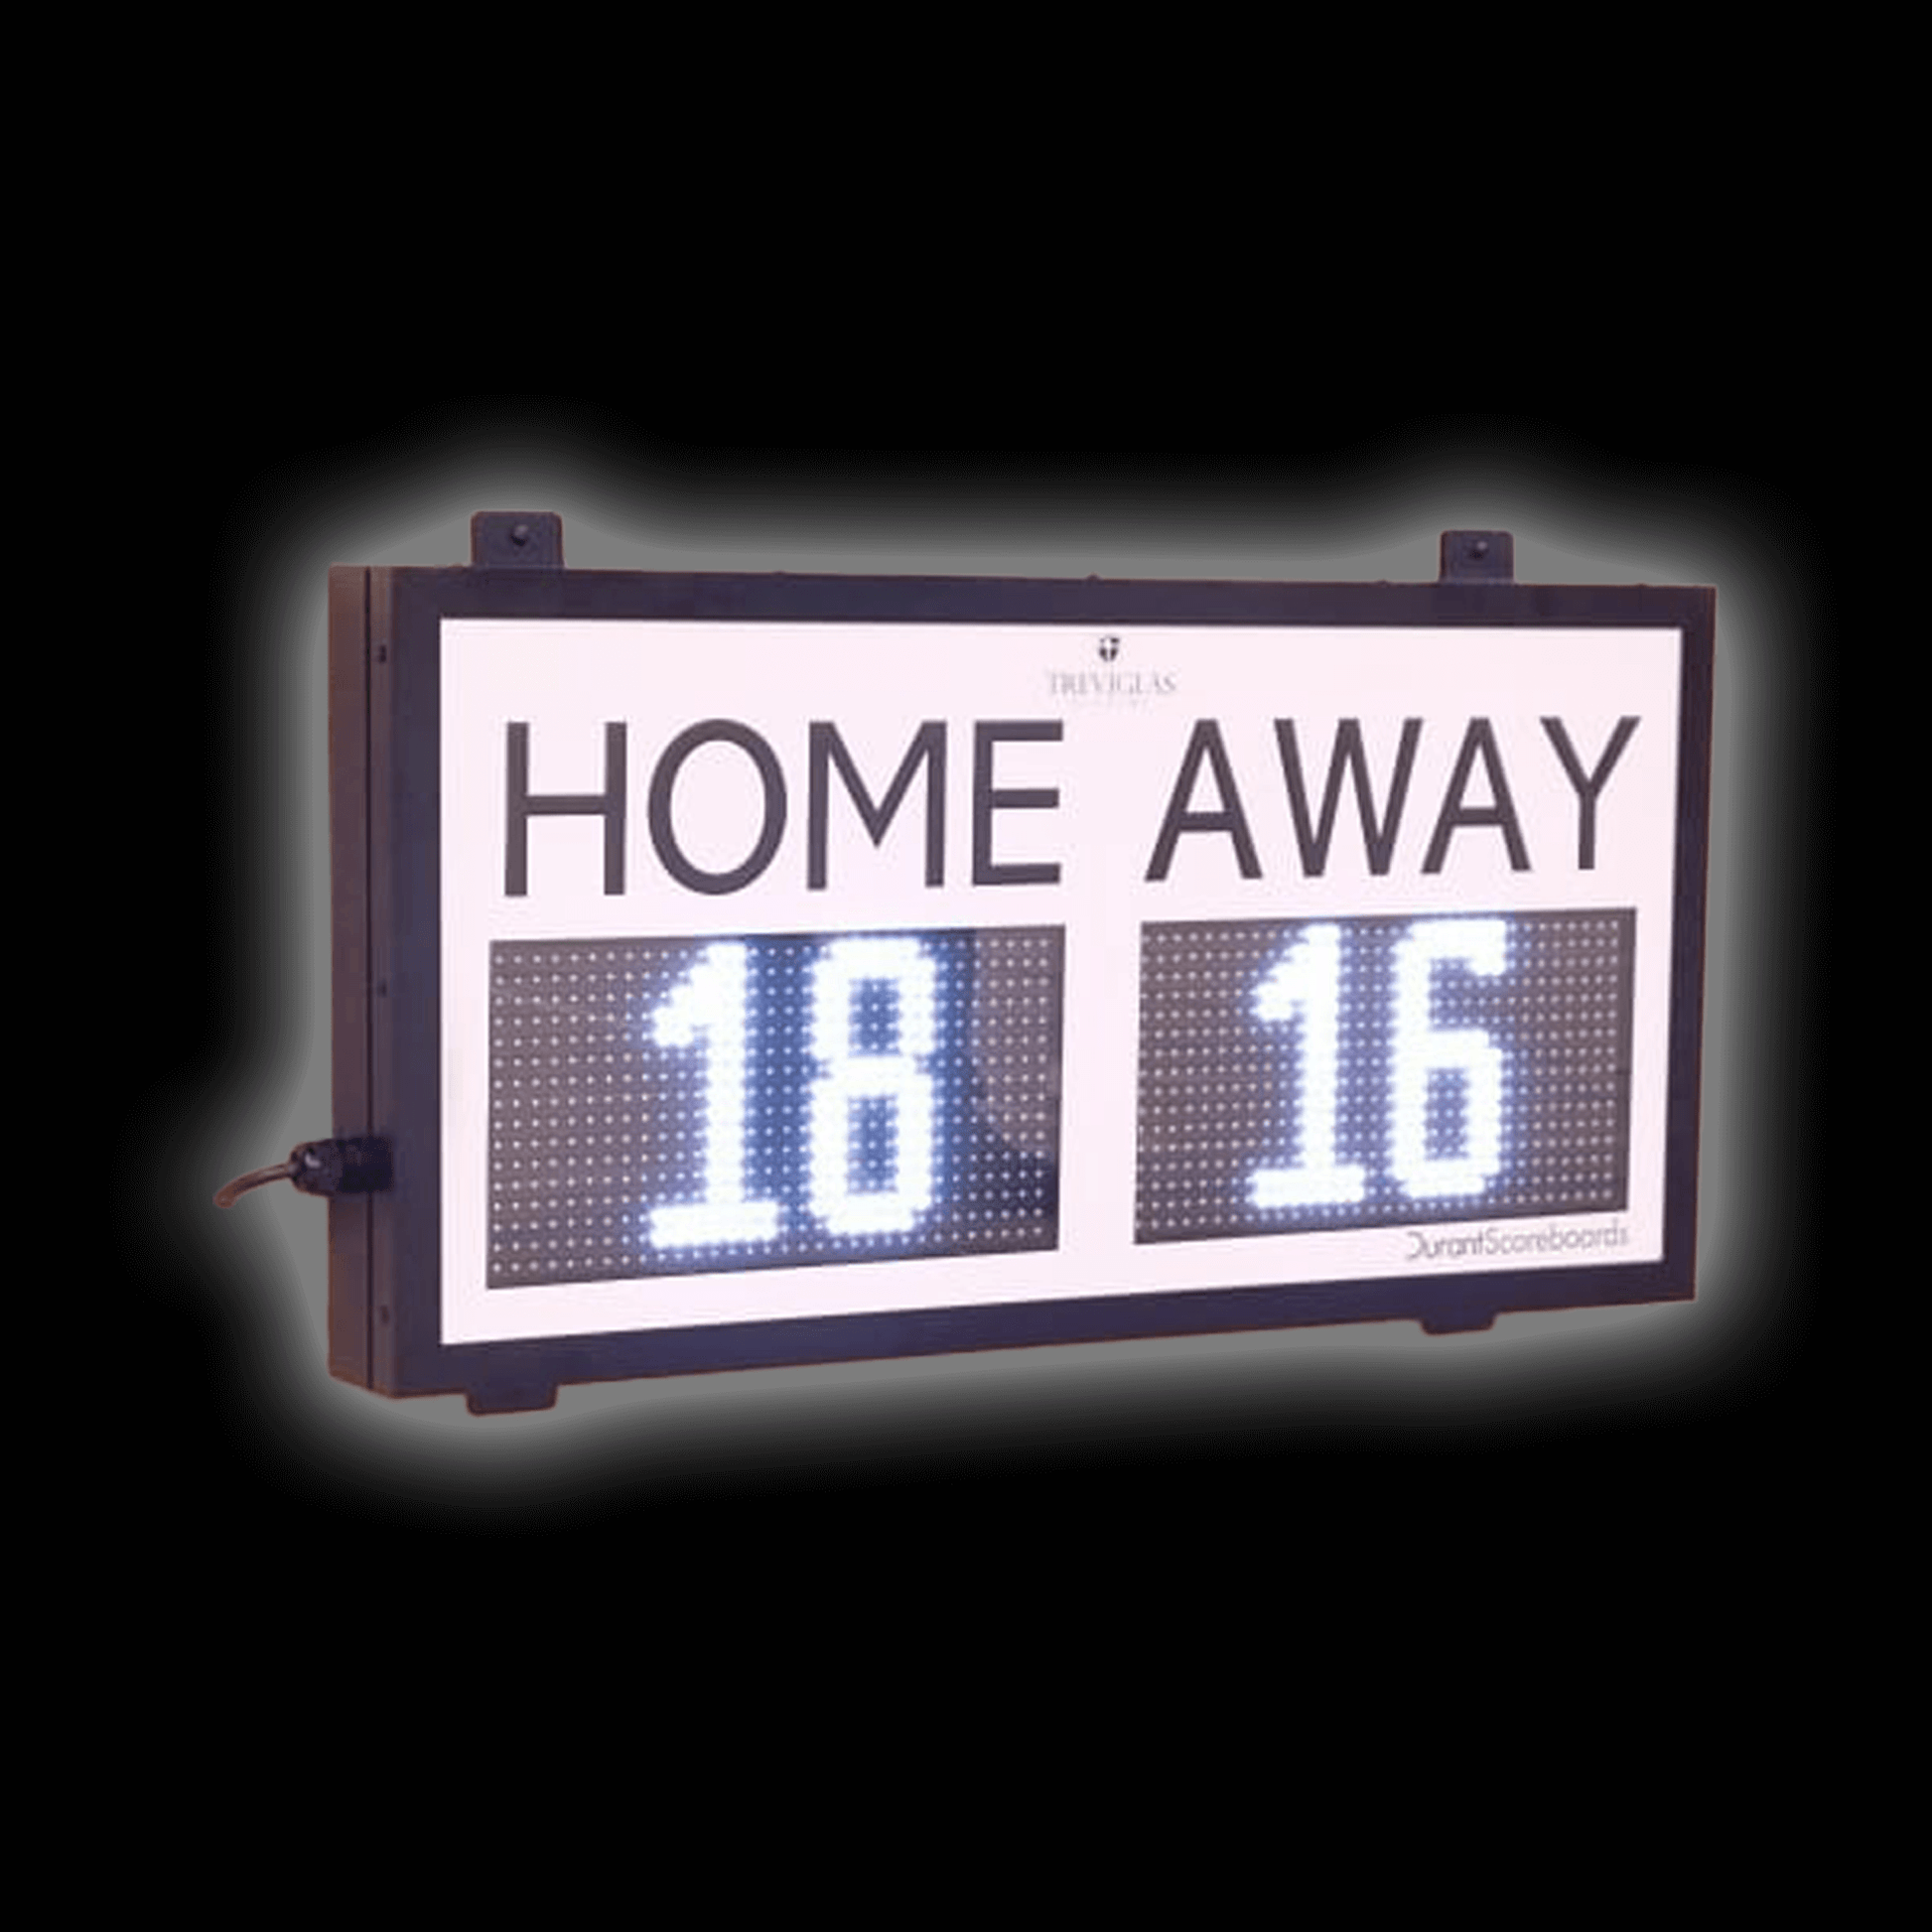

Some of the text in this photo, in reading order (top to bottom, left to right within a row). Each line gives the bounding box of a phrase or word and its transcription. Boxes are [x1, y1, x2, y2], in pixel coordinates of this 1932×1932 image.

[504, 716, 1641, 897] HOME AWAY
[647, 916, 1508, 1250] 18 16
